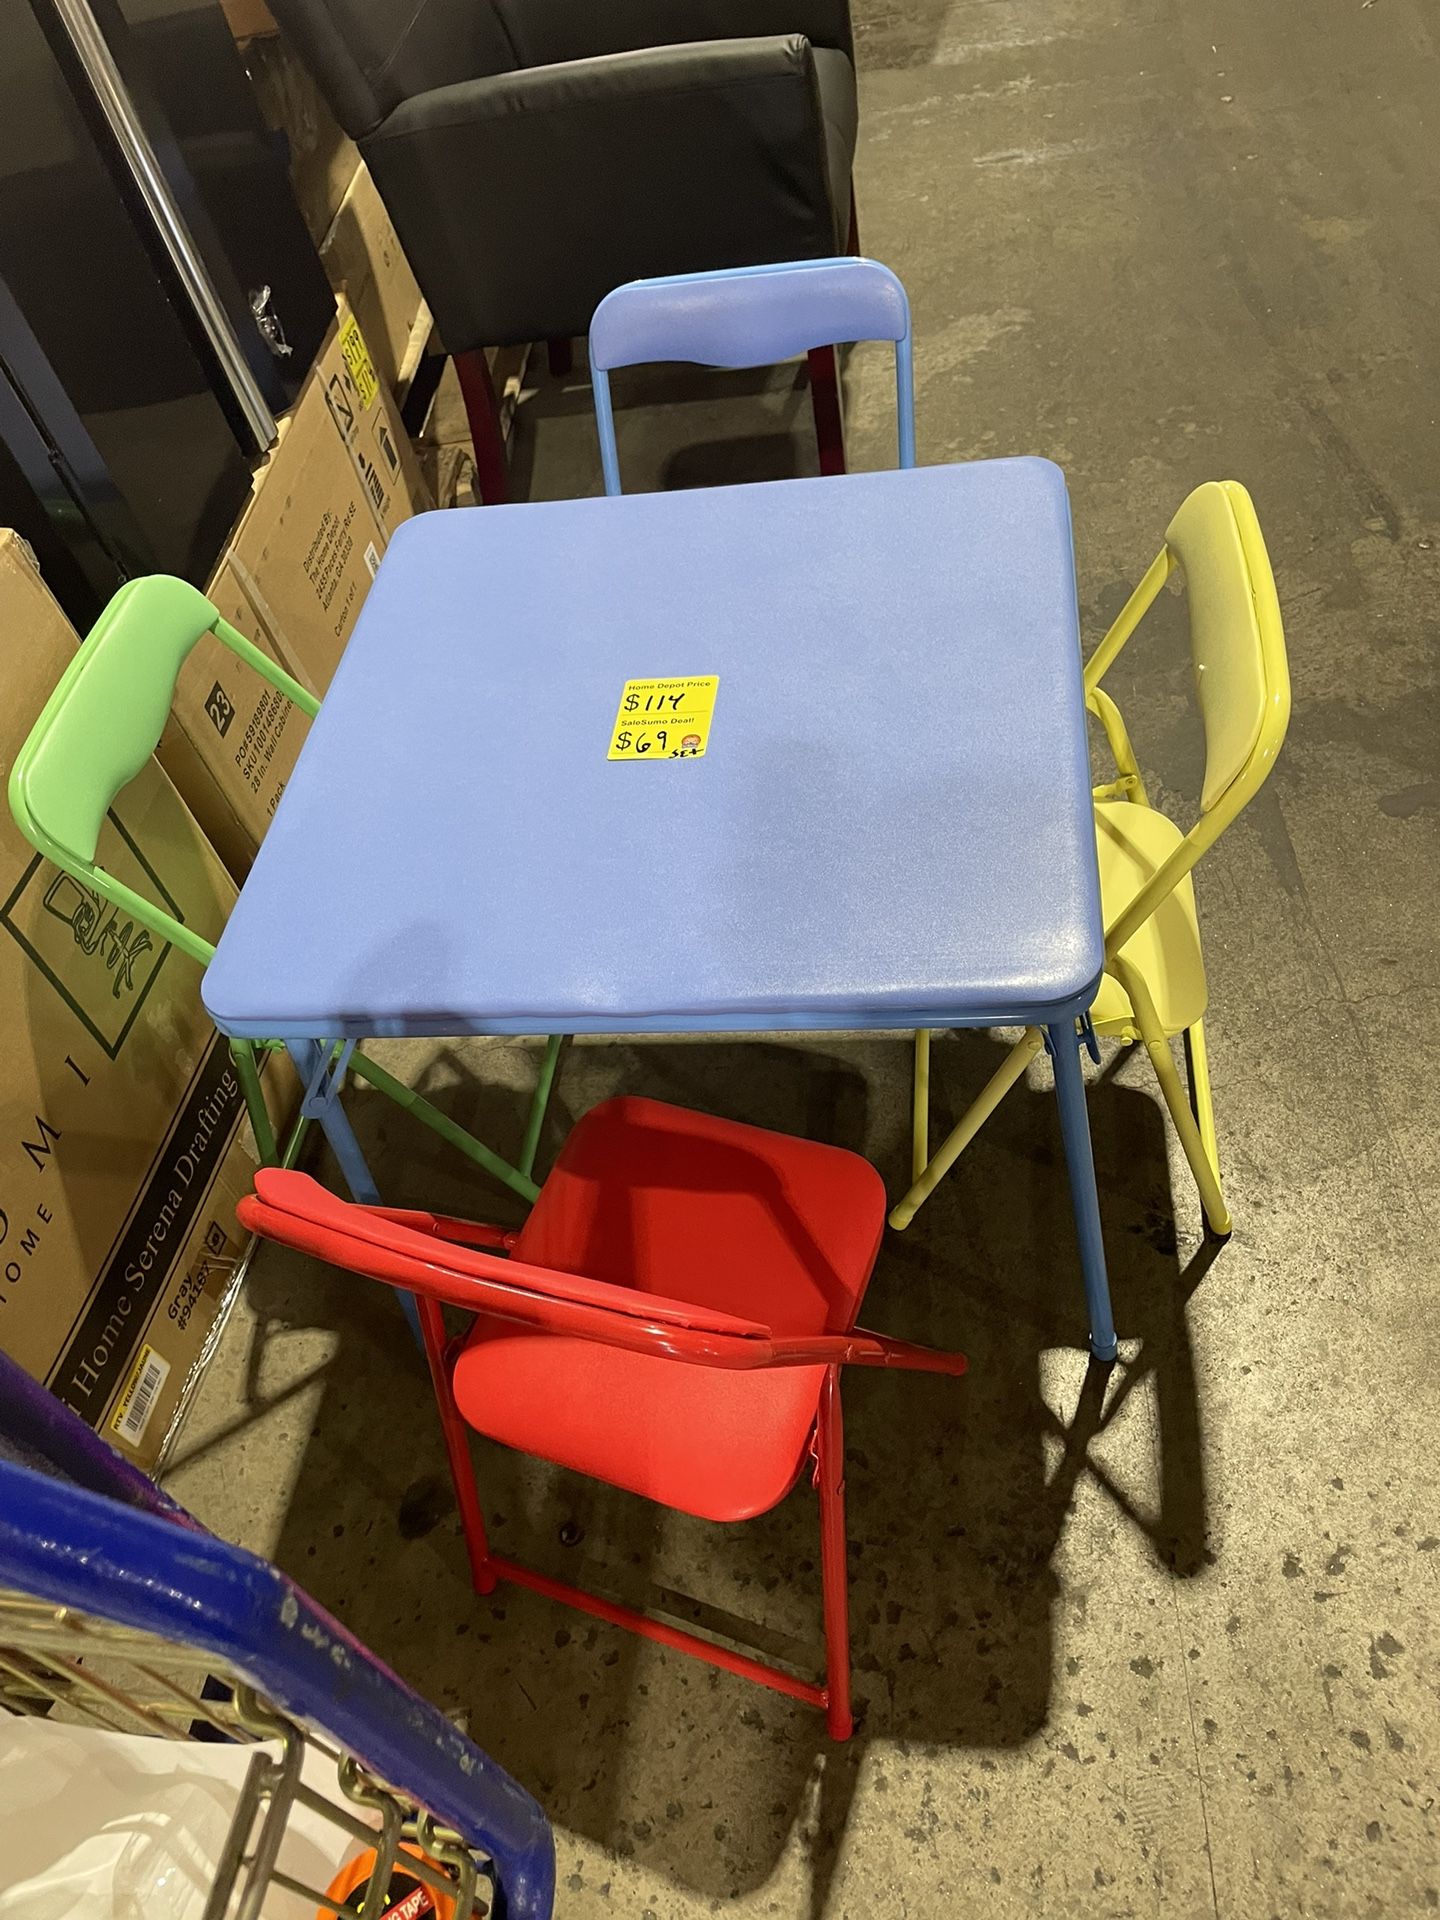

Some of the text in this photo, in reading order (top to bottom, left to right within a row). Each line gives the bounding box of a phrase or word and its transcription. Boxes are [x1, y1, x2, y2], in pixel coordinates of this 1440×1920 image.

[303, 521, 327, 573] Distributed
[309, 514, 340, 585] The Home Depot
[624, 693, 685, 712] $114
[628, 684, 655, 692] Home
[657, 682, 684, 690] Depot
[209, 690, 231, 731] 23
[243, 751, 258, 780] SKU
[263, 735, 278, 762] Wall
[71, 1295, 133, 1397] Home
[124, 1188, 183, 1293] Serena
[173, 1069, 238, 1189] Drafting
[168, 1271, 194, 1320] Gray
[400, 1890, 429, 1920] TAPE
